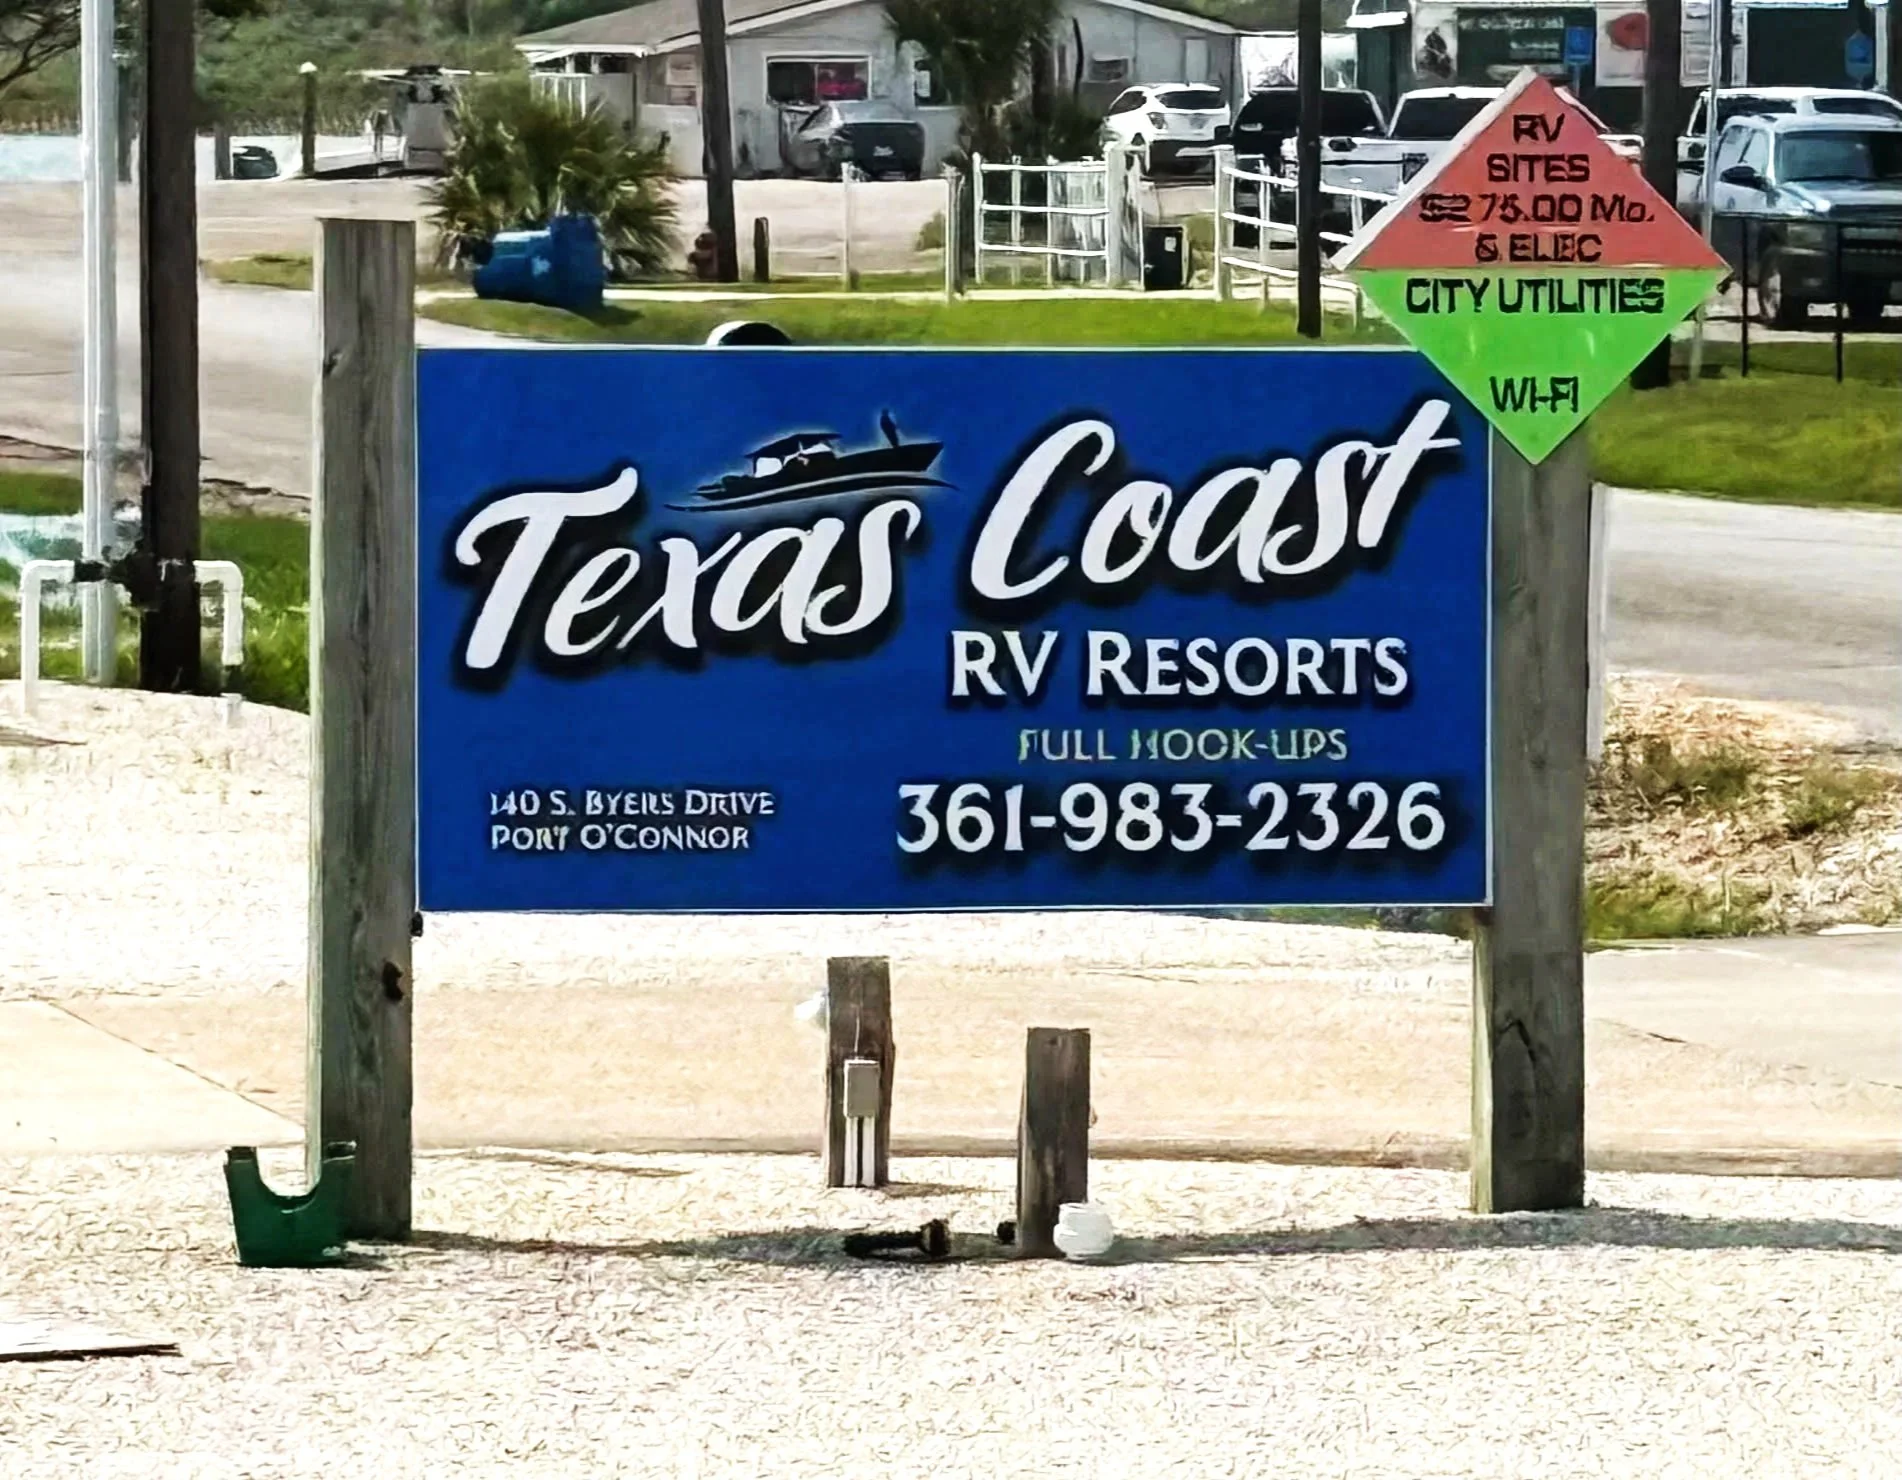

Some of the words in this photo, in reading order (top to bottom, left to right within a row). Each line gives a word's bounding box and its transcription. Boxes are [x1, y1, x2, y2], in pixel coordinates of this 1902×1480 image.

[1513, 113, 1565, 143] RV
[1487, 154, 1590, 182] SITES
[1590, 194, 1655, 223] Mo.
[1509, 234, 1602, 262] ELEC
[1406, 278, 1490, 314] CITY
[1499, 278, 1665, 314] UTILITIES
[1489, 376, 1579, 413] WI-FI
[455, 466, 922, 669] Texas
[970, 399, 1462, 600] Coast
[951, 630, 1057, 697] RV
[1018, 729, 1115, 763] FULL
[1130, 728, 1349, 761] HOOK-UPS
[490, 789, 540, 816] 140
[550, 790, 576, 815] S.
[897, 781, 1446, 854] 361-983-2326
[580, 823, 749, 850] O'CONNOR
